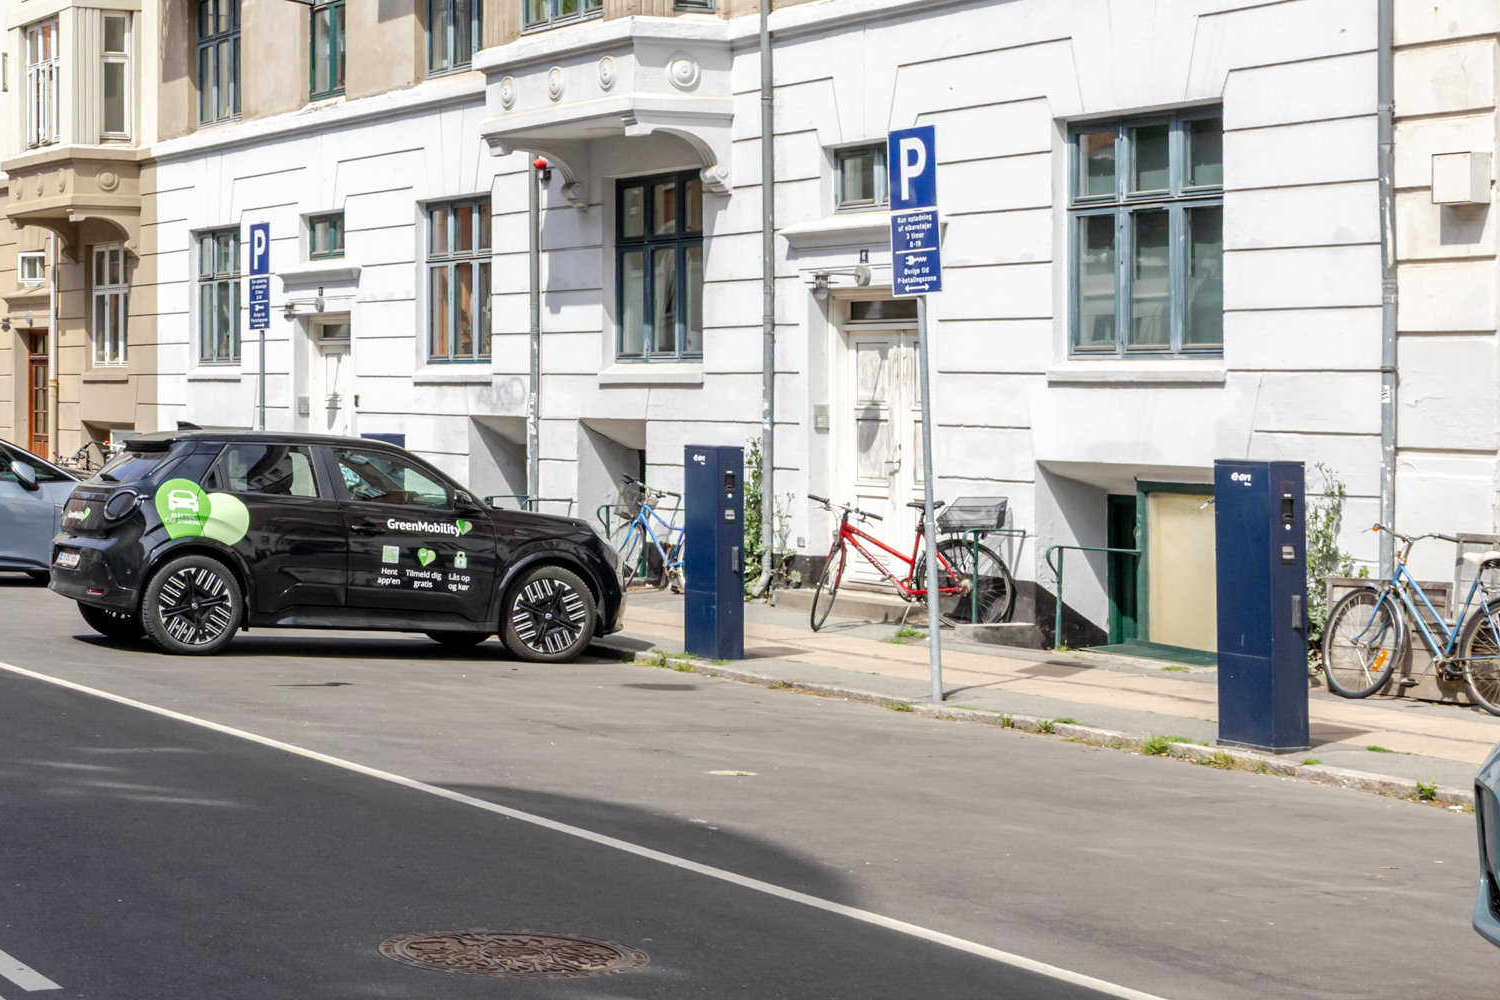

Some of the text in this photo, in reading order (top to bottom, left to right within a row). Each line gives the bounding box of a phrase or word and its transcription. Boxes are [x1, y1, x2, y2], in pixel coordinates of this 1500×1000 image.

[900, 136, 926, 201] P
[253, 229, 266, 270] P
[387, 519, 460, 537] GreenMobility
[381, 567, 398, 576] Hent
[405, 569, 442, 581] Tilmeld dig
[377, 577, 401, 586] app'en
[448, 573, 470, 583] Lås op
[413, 580, 433, 588] gratis
[448, 583, 470, 591] og kør
